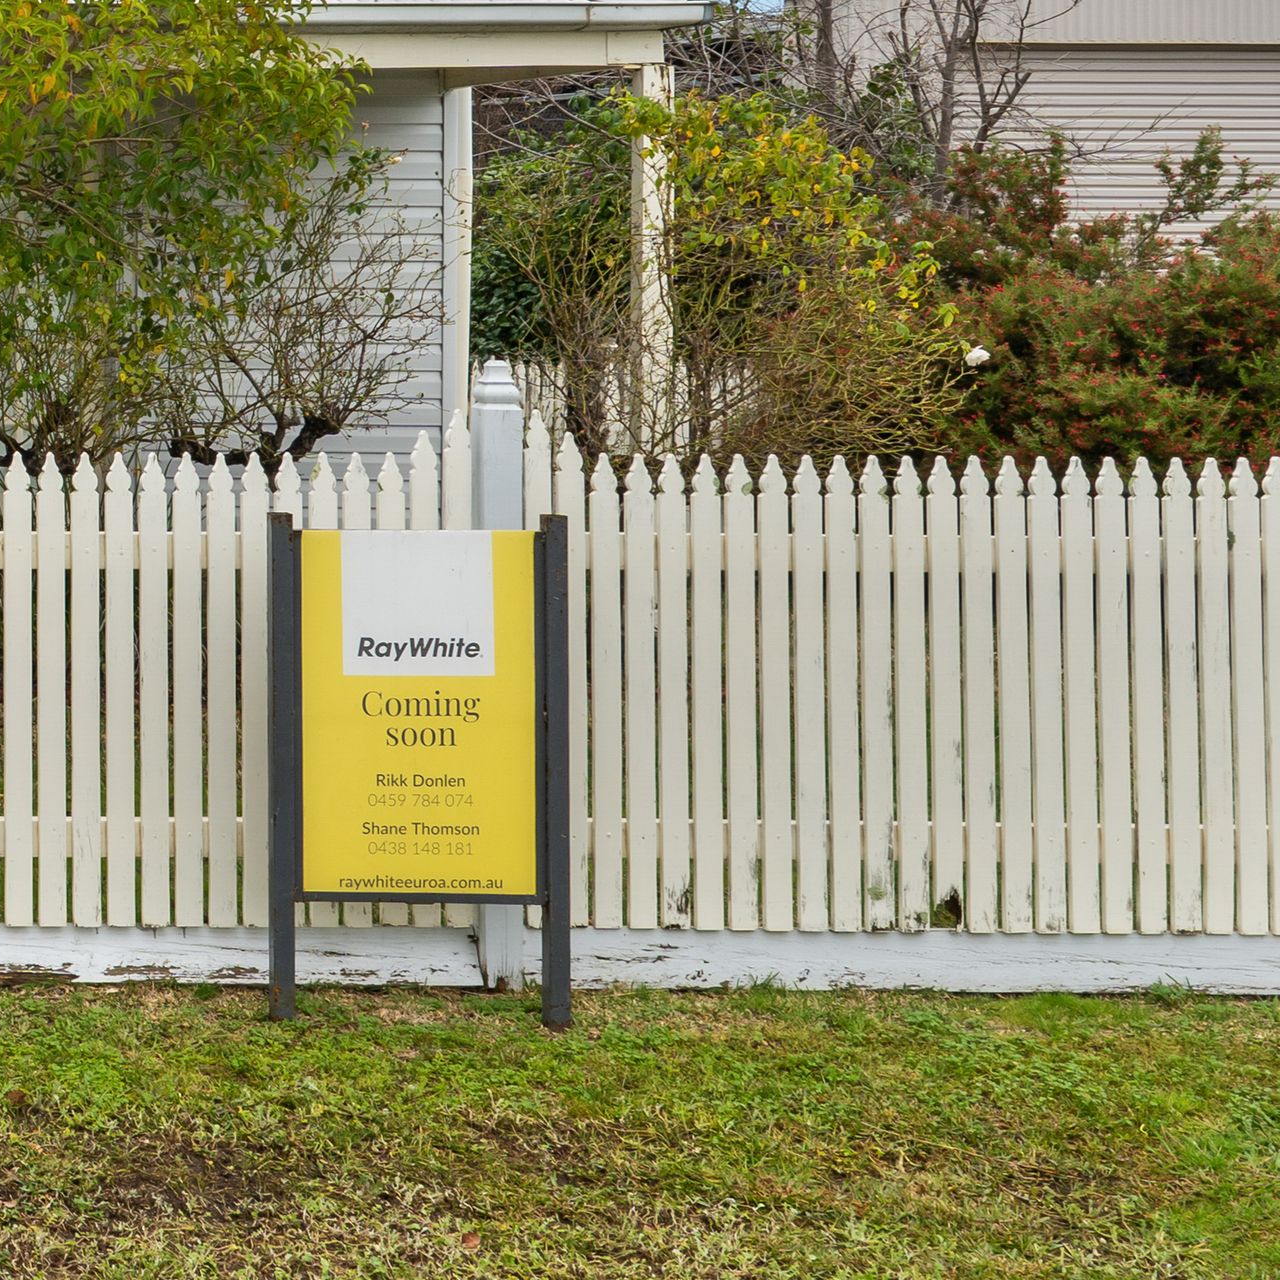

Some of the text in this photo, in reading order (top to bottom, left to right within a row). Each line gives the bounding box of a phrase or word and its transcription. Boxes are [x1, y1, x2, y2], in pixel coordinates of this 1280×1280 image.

[361, 690, 481, 723] Coming
[385, 725, 457, 747] soon
[376, 773, 466, 788] Rikk Donlen
[367, 793, 474, 807] 0459 784 074
[362, 821, 480, 836] Shane Thomson
[367, 841, 473, 856] 0438 148 181
[339, 875, 503, 890] raywhiteeuroa.com.au
